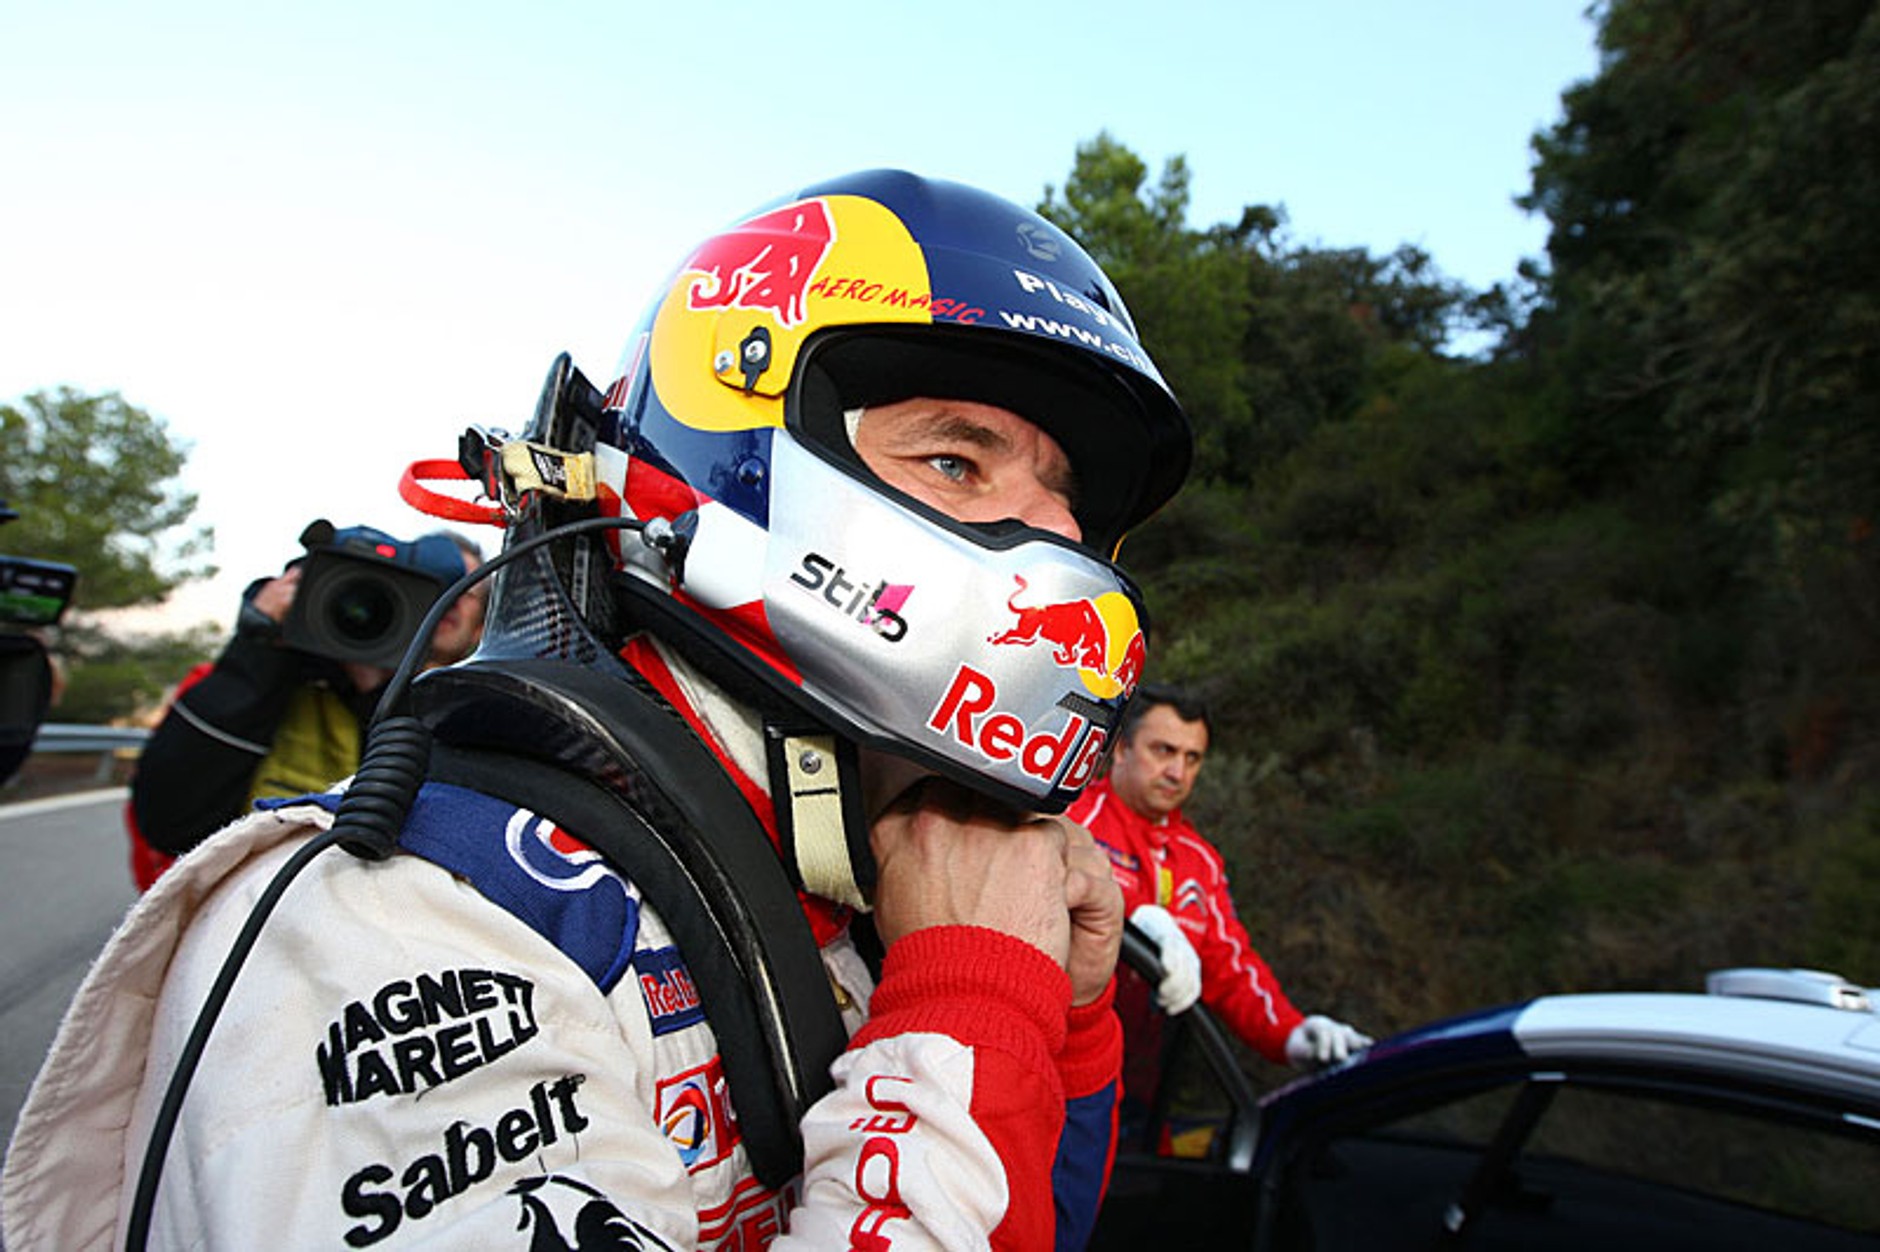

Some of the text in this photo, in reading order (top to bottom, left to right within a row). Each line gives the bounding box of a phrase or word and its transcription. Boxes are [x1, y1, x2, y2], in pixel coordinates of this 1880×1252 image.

[808, 274, 986, 324] AERO MAGIC
[789, 552, 908, 643] Stilo
[927, 663, 1083, 783] Red
[341, 1074, 589, 1248] Sabelt
